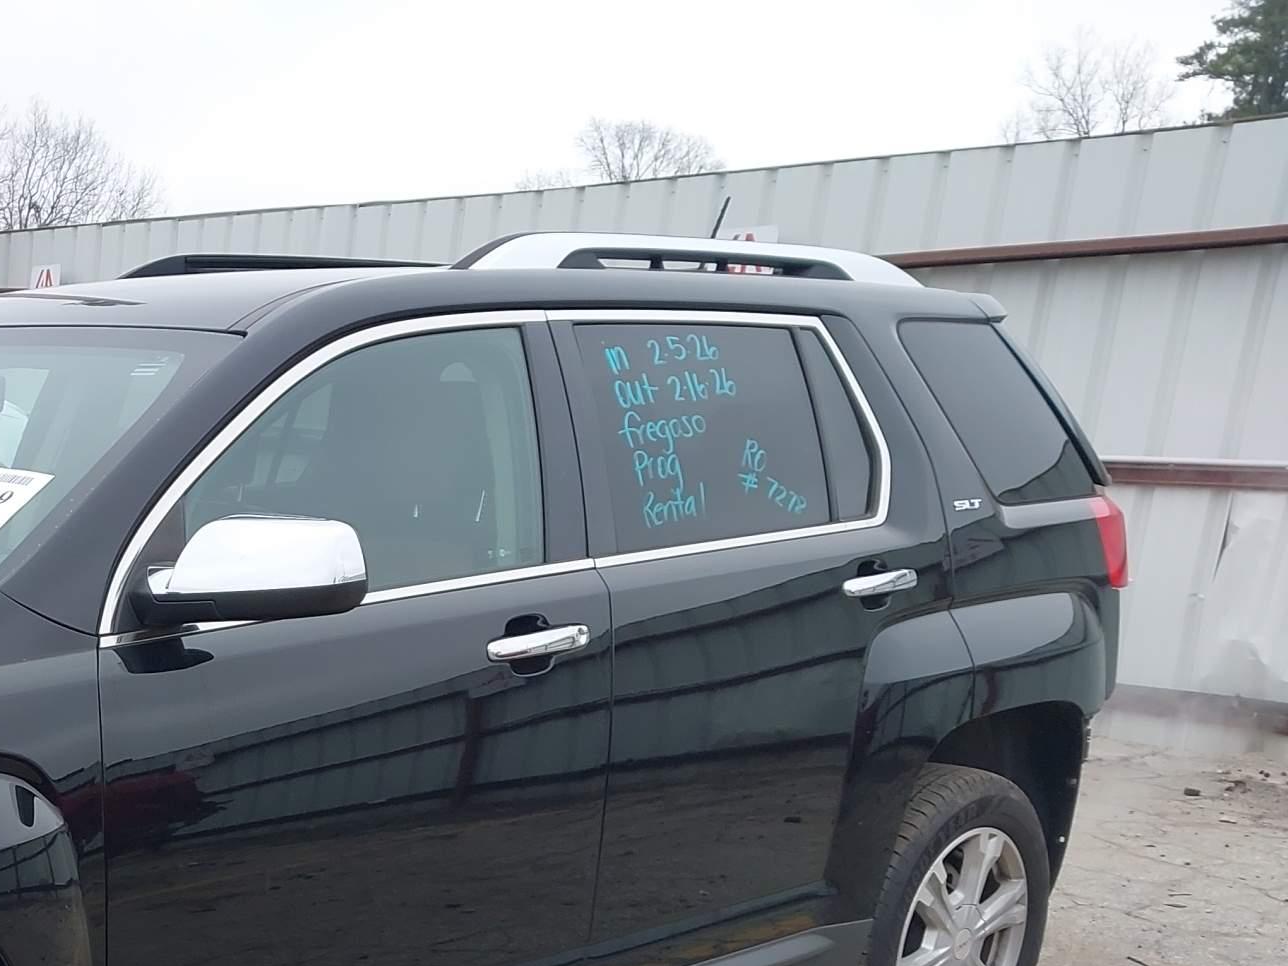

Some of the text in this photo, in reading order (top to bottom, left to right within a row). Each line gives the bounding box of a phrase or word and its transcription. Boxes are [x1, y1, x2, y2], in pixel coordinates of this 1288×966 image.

[614, 373, 658, 408] out
[642, 481, 706, 529] Rental
[952, 498, 983, 512] SLT
